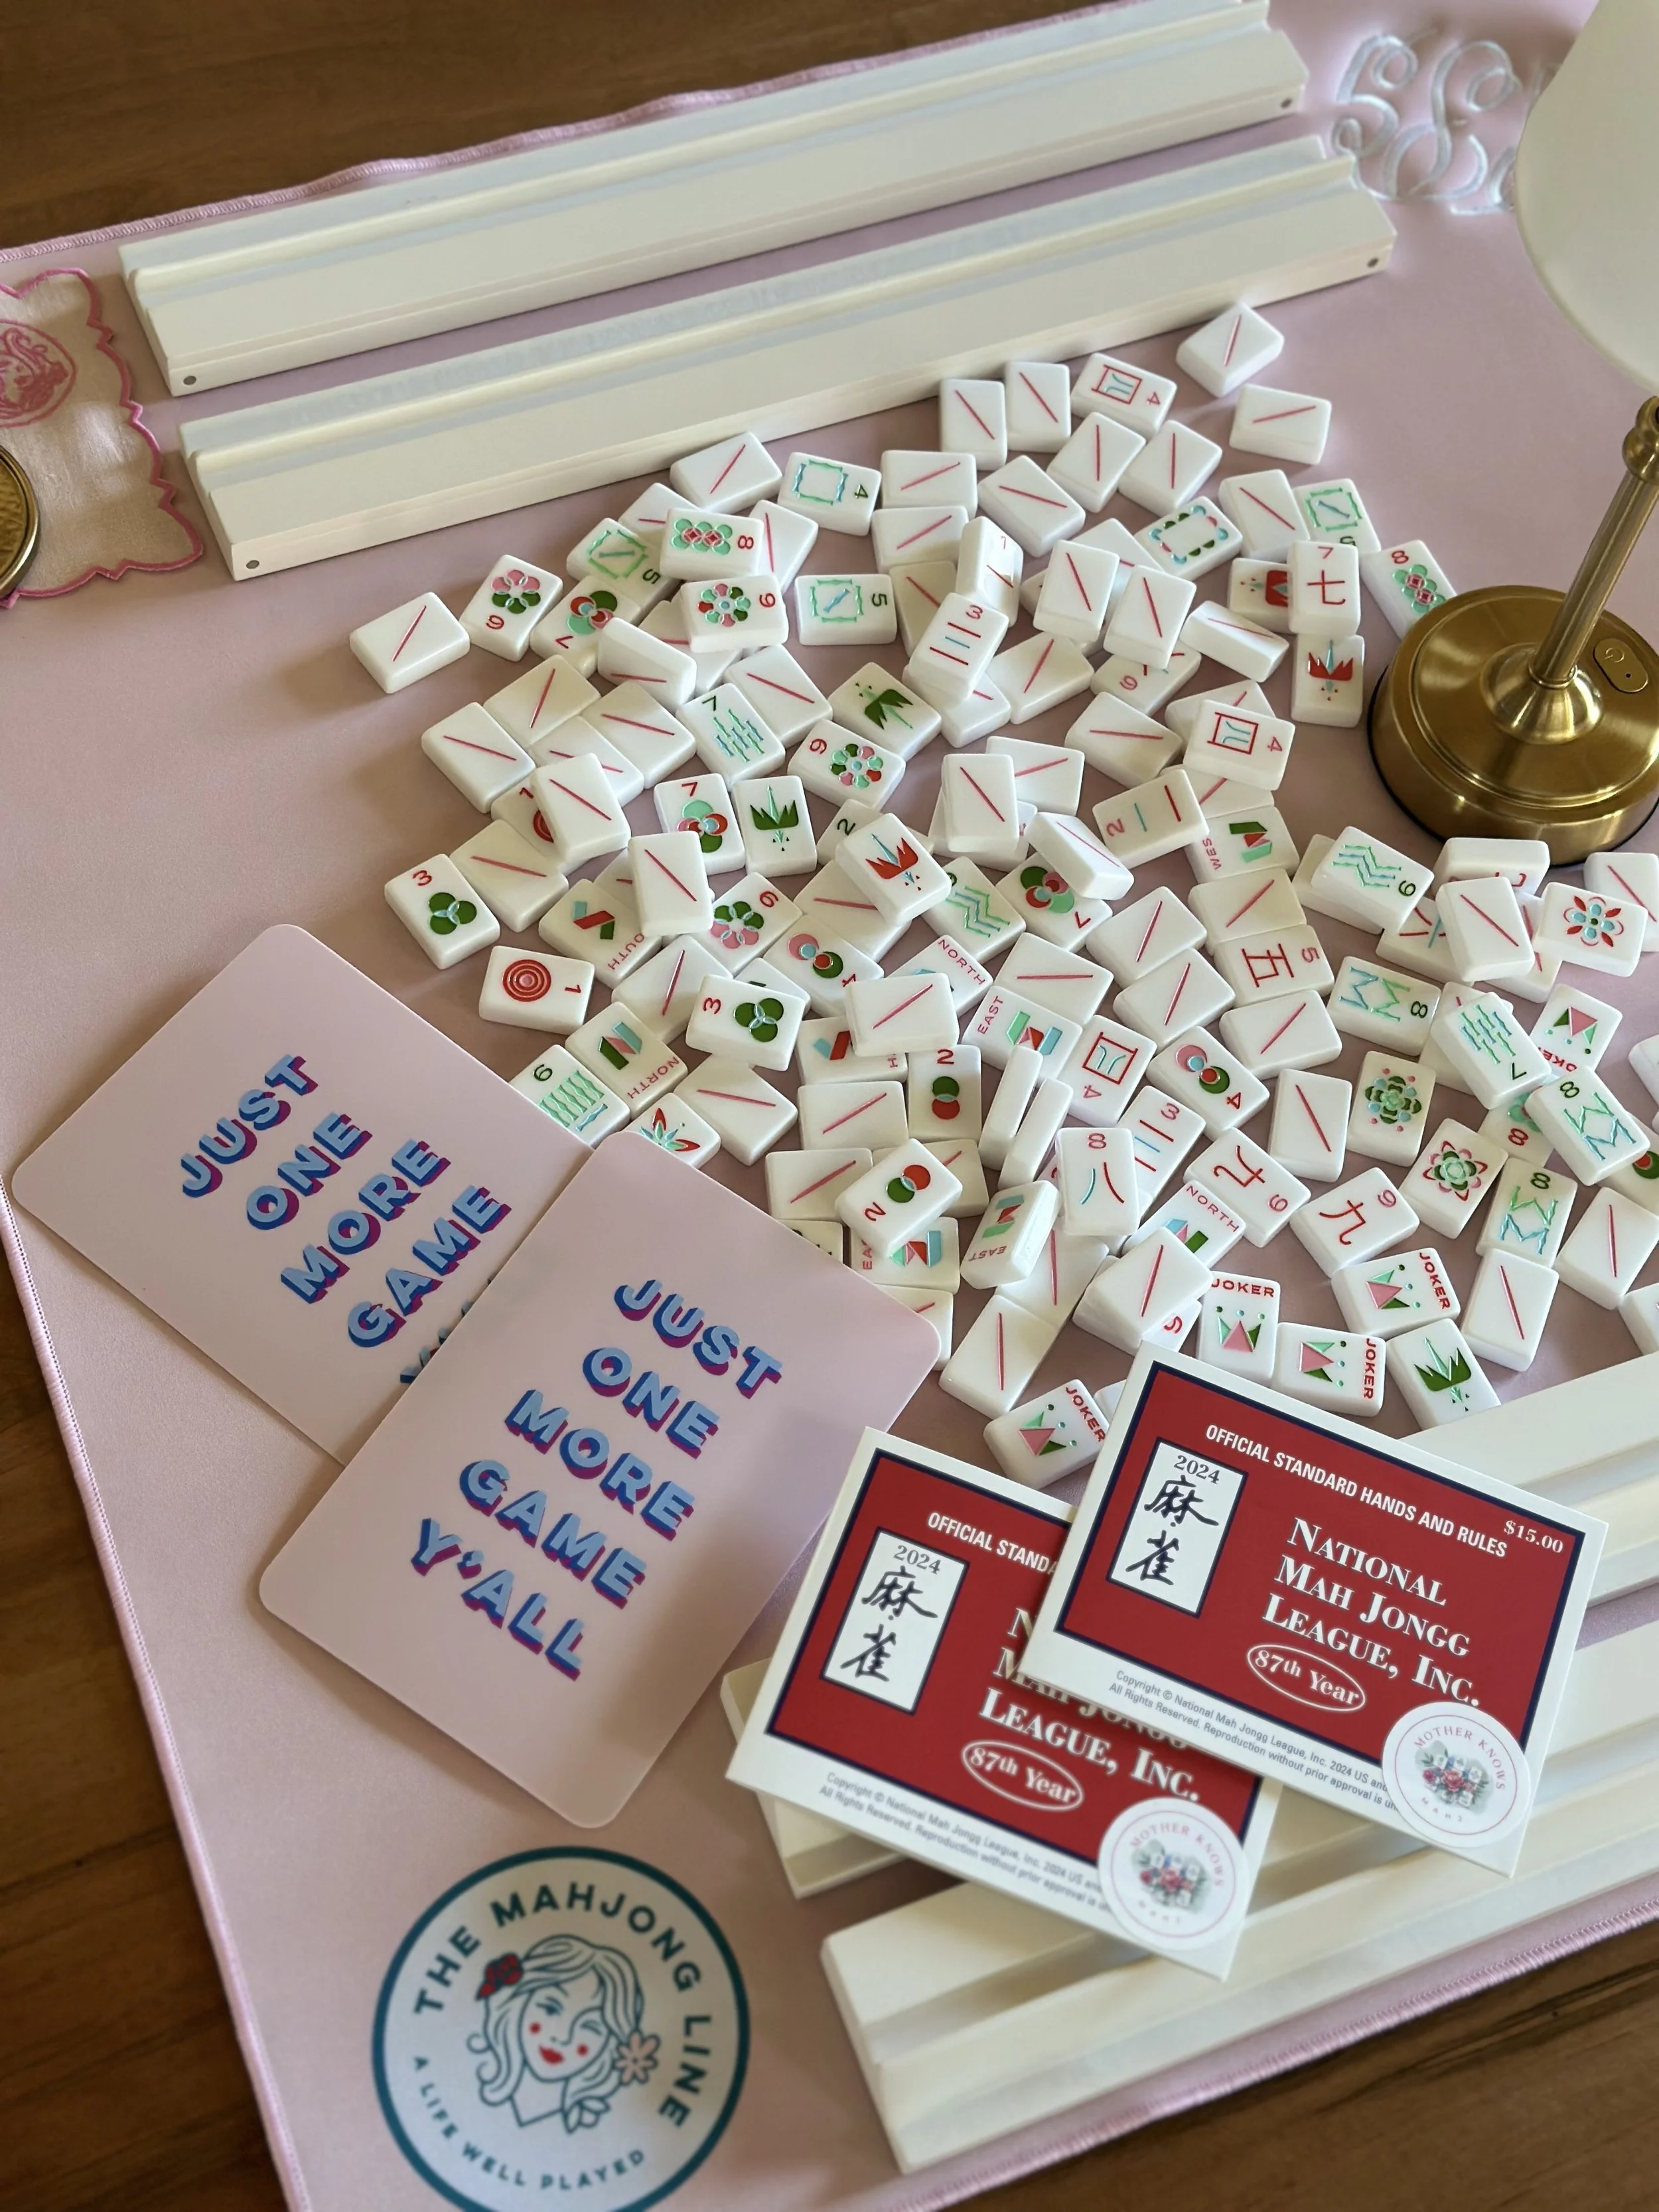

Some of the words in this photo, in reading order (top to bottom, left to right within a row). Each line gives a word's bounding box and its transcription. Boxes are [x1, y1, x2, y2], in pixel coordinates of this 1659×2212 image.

[1147, 392, 1161, 406] 4
[854, 484, 869, 499] 4
[736, 535, 754, 550] 8
[1318, 546, 1333, 559] 7
[1391, 550, 1409, 565] 8
[642, 568, 663, 584] 5
[1306, 569, 1346, 605] 七
[758, 593, 776, 608] 9
[871, 593, 888, 607] 5
[966, 605, 983, 620] 3
[485, 615, 504, 630] 6
[555, 635, 573, 649] 7
[701, 695, 717, 711] 7
[808, 738, 827, 755] 9
[1267, 736, 1283, 752] 4
[681, 781, 698, 797] 7
[836, 818, 857, 836] 2
[1106, 818, 1125, 837] 2
[411, 870, 433, 887] 3
[1398, 880, 1416, 897] 6
[759, 891, 779, 908] 6
[1072, 911, 1091, 929] 7
[607, 933, 646, 971] OUTH
[1301, 946, 1320, 963] 5
[938, 938, 986, 986] NORTH
[564, 984, 581, 994] 1
[701, 997, 721, 1015] 3
[977, 995, 1003, 1035] EAST
[1410, 1001, 1428, 1019] 8
[937, 1049, 954, 1065] 2
[1538, 1047, 1577, 1072] OKE
[534, 1064, 553, 1082] 6
[626, 1055, 680, 1100] NORTH
[1512, 1063, 1527, 1080] 7
[1083, 1084, 1102, 1098] 4
[1559, 1081, 1579, 1098] 8
[1226, 1092, 1241, 1110] 4
[1161, 1102, 1180, 1120] 3
[181, 1054, 318, 1197] JUST
[1088, 1133, 1106, 1149] 8
[1508, 1128, 1529, 1146] 8
[247, 1112, 372, 1230] ONE
[1530, 1172, 1551, 1189] 8
[1269, 1194, 1288, 1212] 9
[1377, 1189, 1396, 1208] 9
[863, 1201, 886, 1222] 2
[1186, 1185, 1240, 1232] NORTH
[281, 1139, 451, 1304] MORE
[968, 1246, 1007, 1261] EAST
[348, 1185, 512, 1347] GAME
[1211, 1278, 1274, 1297] JOKER
[1419, 1252, 1451, 1310] JOKER
[614, 1279, 782, 1399] JUST
[1363, 1337, 1376, 1399] JOKER
[583, 1347, 719, 1459] ONE
[1065, 1387, 1106, 1442] JOKER
[505, 1390, 695, 1541] MORE
[1173, 1455, 1220, 1485] 2024
[1206, 1424, 1269, 1463] OFFICIAL
[1273, 1451, 1358, 1497] STANDARD
[1360, 1487, 1417, 1521] HANDS
[1418, 1511, 1455, 1536] AND
[1457, 1525, 1508, 1558] RULES
[459, 1460, 646, 1609] GAME
[928, 1512, 993, 1552] OFFICIAL
[996, 1539, 1058, 1576] STANDA
[1504, 1520, 1563, 1554] $15.00
[894, 1545, 941, 1576] 2024
[1287, 1517, 1447, 1606] NATIONAL
[411, 1518, 584, 1681] Y'ALL
[1274, 1554, 1354, 1610] MAH
[1360, 1592, 1470, 1657] JONGG
[1254, 1649, 1301, 1678] 87th
[1309, 1669, 1359, 1705] Year
[1116, 1670, 1161, 1696] Copyright
[1175, 1694, 1214, 1719] National
[1216, 1712, 1237, 1729] Mah
[1239, 1724, 1268, 1744] Jongg
[1271, 1735, 1306, 1759] League,
[1310, 1751, 1327, 1767] Inc.
[1330, 1760, 1352, 1777] 2024
[1354, 1770, 1369, 1784] US
[1109, 1683, 1122, 1693] All
[1124, 1689, 1153, 1708] Rights
[1155, 1702, 1200, 1729] Reserved.
[1204, 1722, 1265, 1755] Reproduction
[1268, 1751, 1304, 1772] without
[1305, 1767, 1328, 1783] prior
[1330, 1777, 1372, 1801] approval
[1374, 1794, 1383, 1805] is
[1414, 1726, 1473, 1749] MOTHER
[1478, 1739, 1506, 1790] KNOWS
[971, 1747, 1019, 1777] 87th
[1025, 1767, 1076, 1803] Year
[828, 1772, 872, 1798] Copyright
[887, 1796, 926, 1820] National
[928, 1813, 950, 1830] Mah
[952, 1823, 981, 1844] Jongg
[1044, 1862, 1067, 1878] 2024
[1068, 1872, 1083, 1885] US
[820, 1785, 833, 1798] All
[835, 1792, 864, 1812] Rights
[916, 1824, 977, 1858] Reproduction
[981, 1852, 1017, 1874] without
[1043, 1879, 1086, 1902] approval
[1130, 1822, 1190, 1848] MOTHER
[1195, 1834, 1224, 1887] KNOWS
[413, 1925, 481, 2016] THE
[490, 1882, 701, 1992] MAHJONG
[658, 2015, 712, 2129] LINE
[414, 2057, 429, 2073] A
[419, 2082, 459, 2140] LIFE
[462, 2142, 526, 2187] WELL
[541, 2149, 644, 2191] PLAYED
